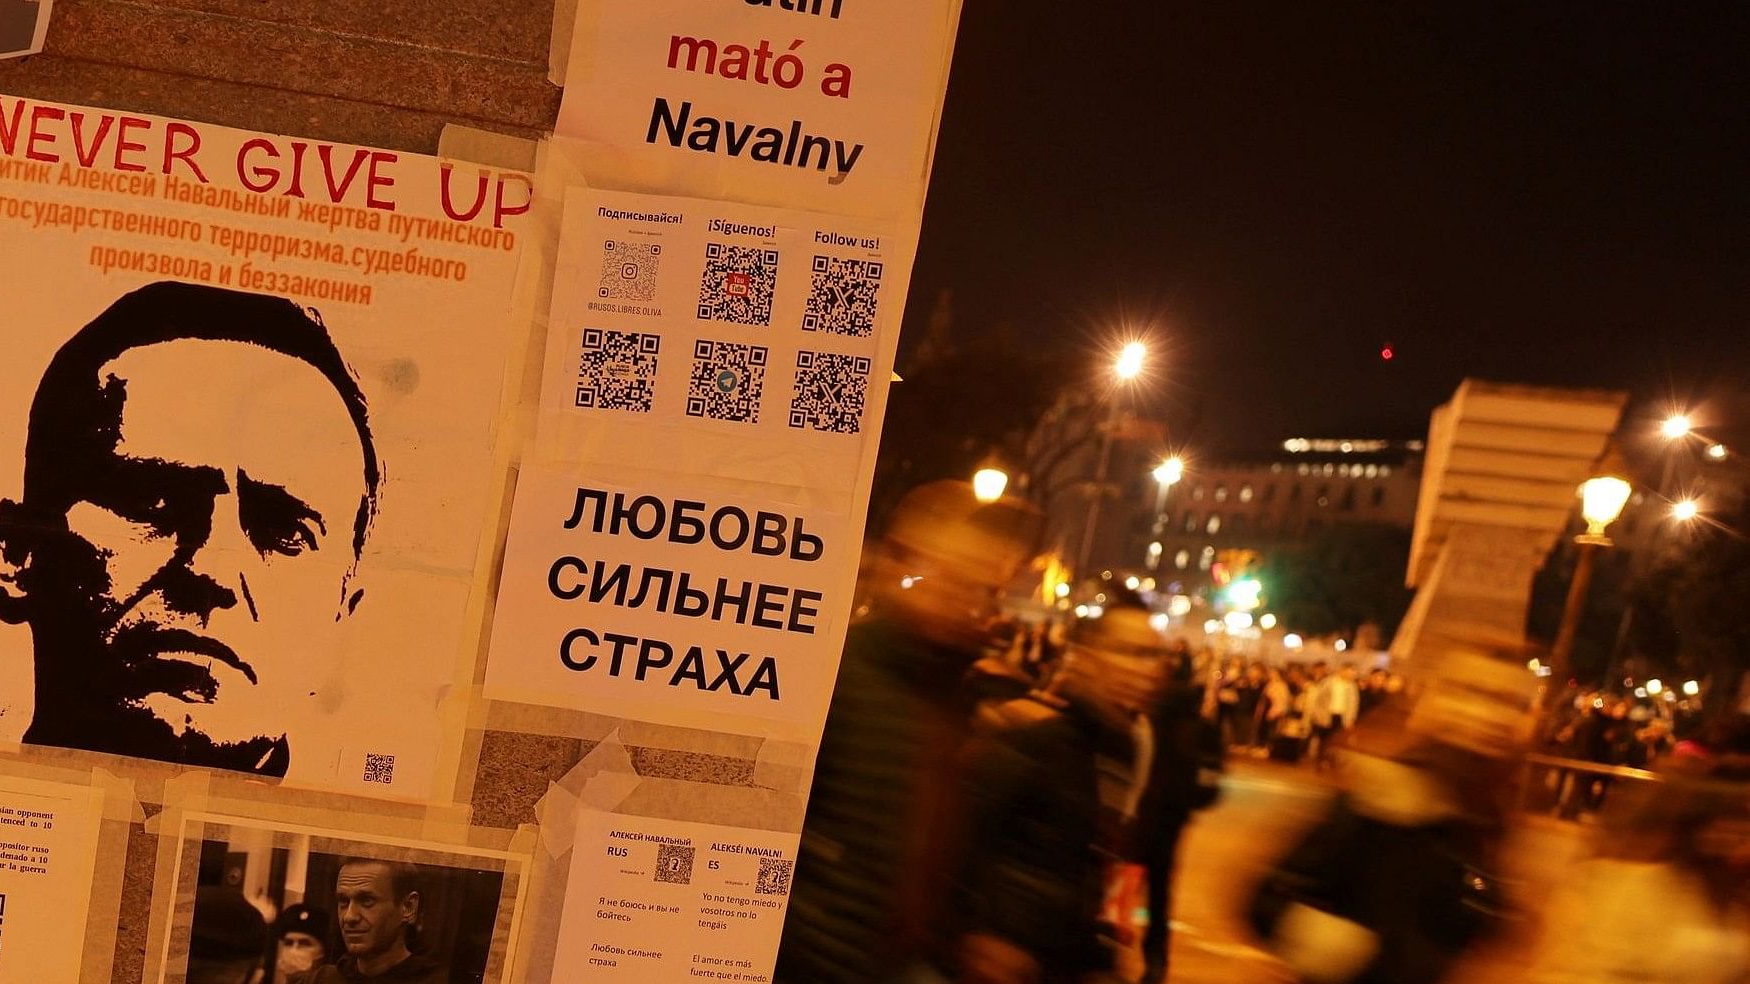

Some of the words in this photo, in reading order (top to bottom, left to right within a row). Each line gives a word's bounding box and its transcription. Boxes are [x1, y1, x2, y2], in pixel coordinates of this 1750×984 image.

[667, 35, 804, 89] mató
[820, 63, 852, 99] a
[646, 97, 864, 185] Navalny
[236, 138, 397, 211] GIVE
[440, 162, 533, 228] UP
[58, 162, 155, 198] Алексей
[163, 176, 290, 218] Навальный
[297, 200, 381, 232] жертва
[388, 212, 515, 251] путинского
[598, 206, 683, 224] Подписывайся!
[708, 219, 776, 238] ¡Síguenos!
[814, 230, 857, 246] Follow
[861, 238, 880, 250] us!
[90, 245, 211, 282] произвола
[218, 266, 232, 286] и
[239, 261, 372, 305] беззакония
[564, 488, 824, 561] ЛЮБОВЬ
[548, 556, 823, 634] СИЛЬНЕЕ
[560, 628, 780, 700] СТРАХА
[17, 810, 53, 820] opponent
[30, 820, 38, 828] to
[609, 830, 644, 841] АЛЕКСЕЙ
[645, 834, 691, 846] НАВАЛЬНЫЙ
[32, 846, 49, 854] ruso
[607, 846, 628, 857] RUS
[745, 847, 782, 858] NAVALNI
[39, 856, 48, 864] 10
[708, 860, 720, 870] ES
[9, 862, 17, 870] la
[20, 865, 46, 874] guerra
[598, 897, 605, 905] Я
[607, 899, 618, 907] не
[619, 899, 647, 910] боюсь
[703, 892, 712, 901] Yo
[726, 896, 750, 906] tengo
[751, 898, 777, 908] miedo
[778, 902, 783, 910] y
[596, 910, 631, 922] бойтесь
[700, 907, 735, 917] vosotros
[736, 911, 748, 919] no
[749, 910, 757, 919] lo
[698, 920, 727, 930] tengáis
[591, 943, 626, 955] Любовь
[627, 949, 662, 959] сильнее
[589, 958, 617, 967] страха
[692, 954, 700, 963] El
[701, 957, 723, 965] amor
[735, 960, 752, 968] más
[690, 967, 715, 978] fuerte
[716, 972, 732, 980] que
[733, 972, 742, 980] el
